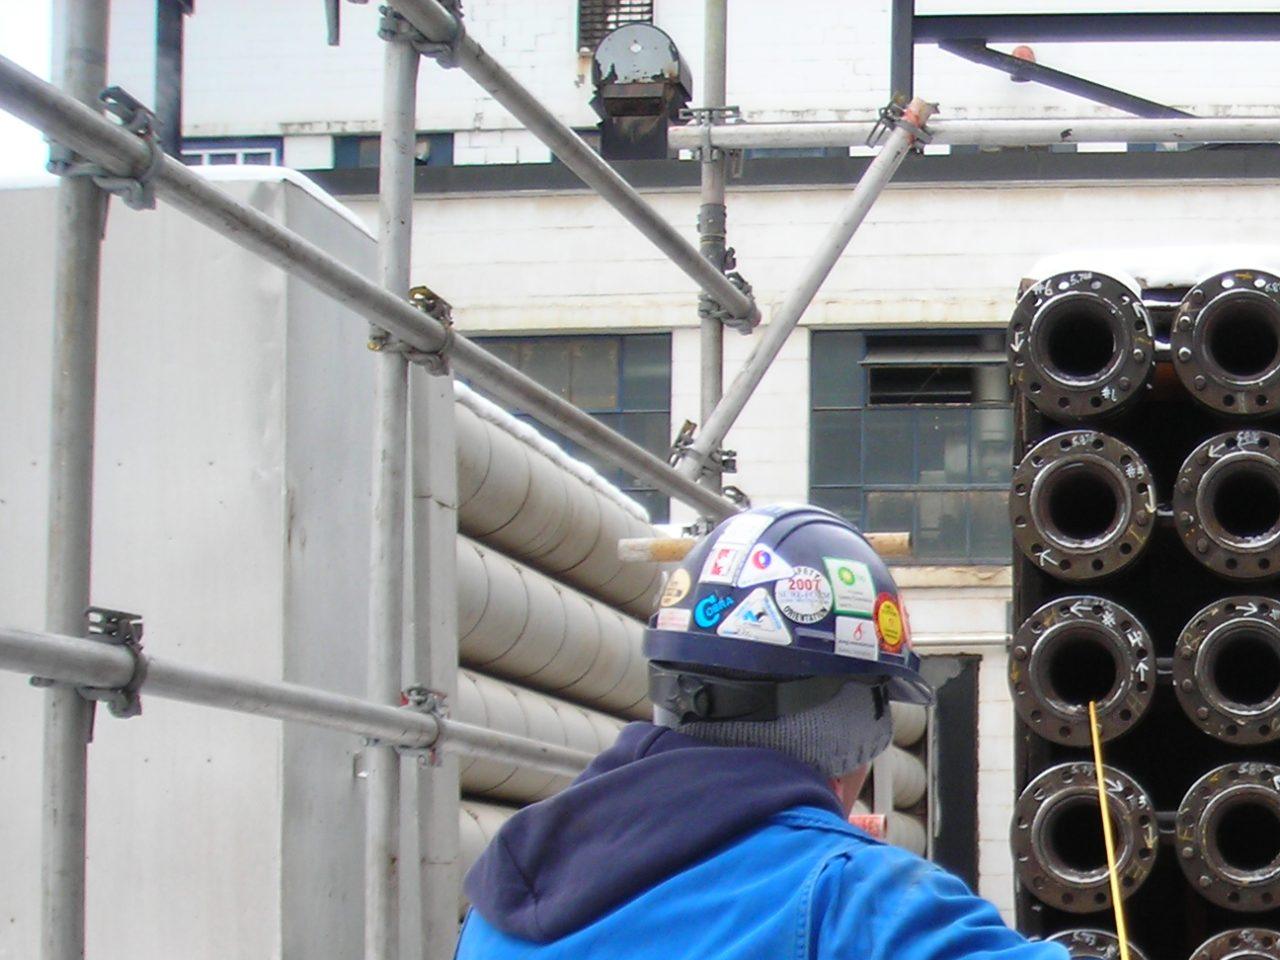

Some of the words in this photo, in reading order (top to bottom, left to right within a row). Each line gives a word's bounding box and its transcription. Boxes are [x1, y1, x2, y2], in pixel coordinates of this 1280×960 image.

[788, 579, 821, 591] 2007
[694, 594, 735, 629] COBRA
[782, 604, 828, 622] ORIENTATION
